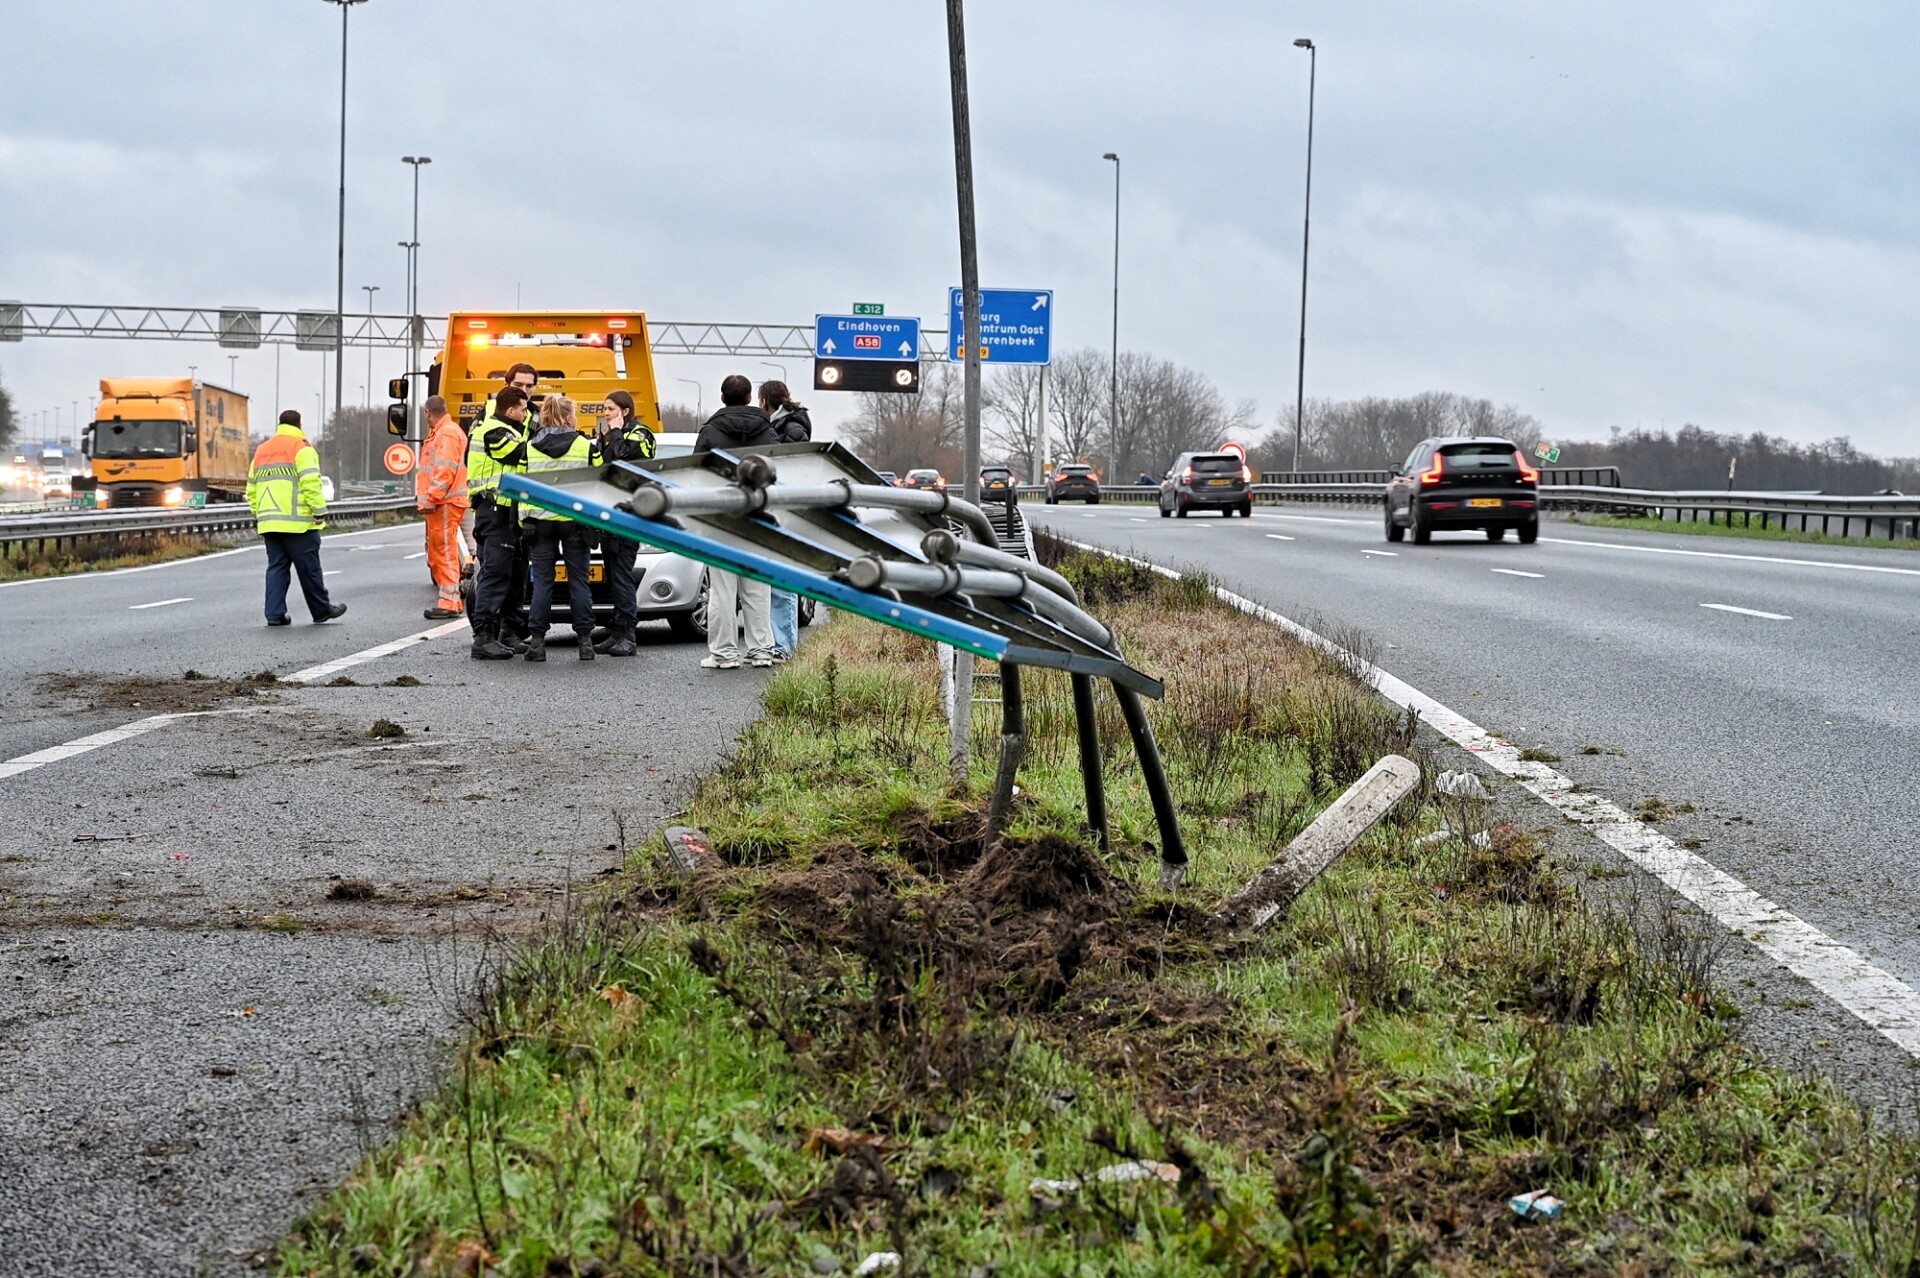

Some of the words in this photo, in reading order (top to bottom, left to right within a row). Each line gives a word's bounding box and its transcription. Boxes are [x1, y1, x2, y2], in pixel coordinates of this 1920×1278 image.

[854, 304, 862, 313] E
[864, 305, 881, 314] 312
[838, 321, 901, 332] Eindhoven
[1019, 324, 1044, 335] Oost
[856, 338, 879, 347] A58
